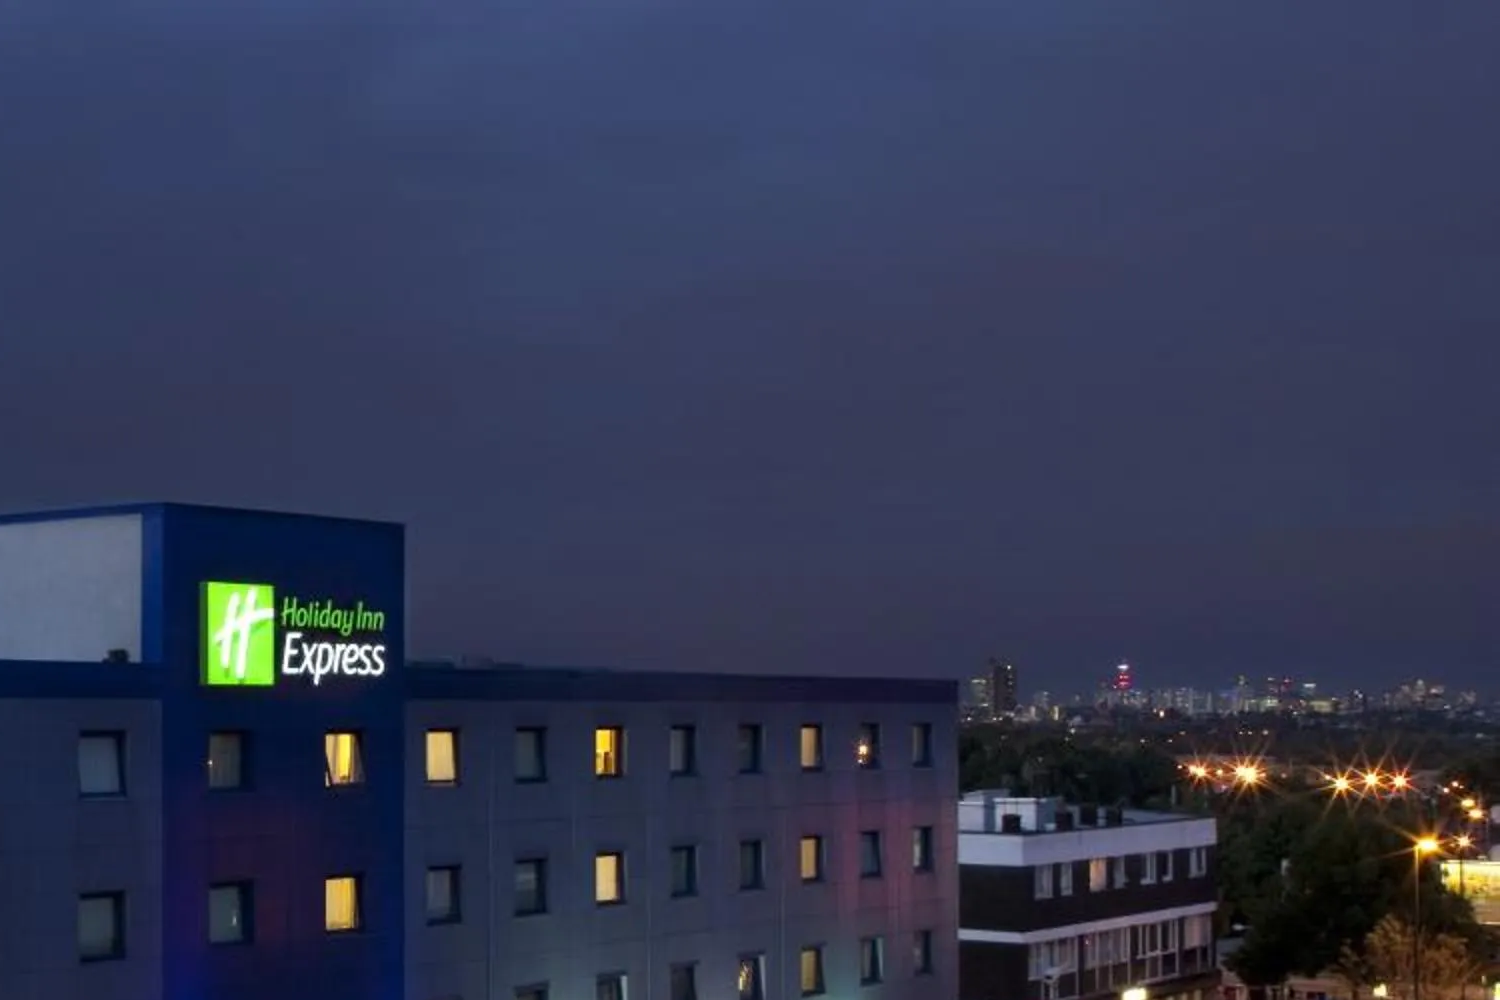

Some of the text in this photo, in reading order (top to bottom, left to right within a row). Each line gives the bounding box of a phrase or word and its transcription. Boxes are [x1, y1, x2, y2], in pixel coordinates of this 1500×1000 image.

[281, 596, 385, 637] Holiday Inn
[281, 631, 385, 686] Express
